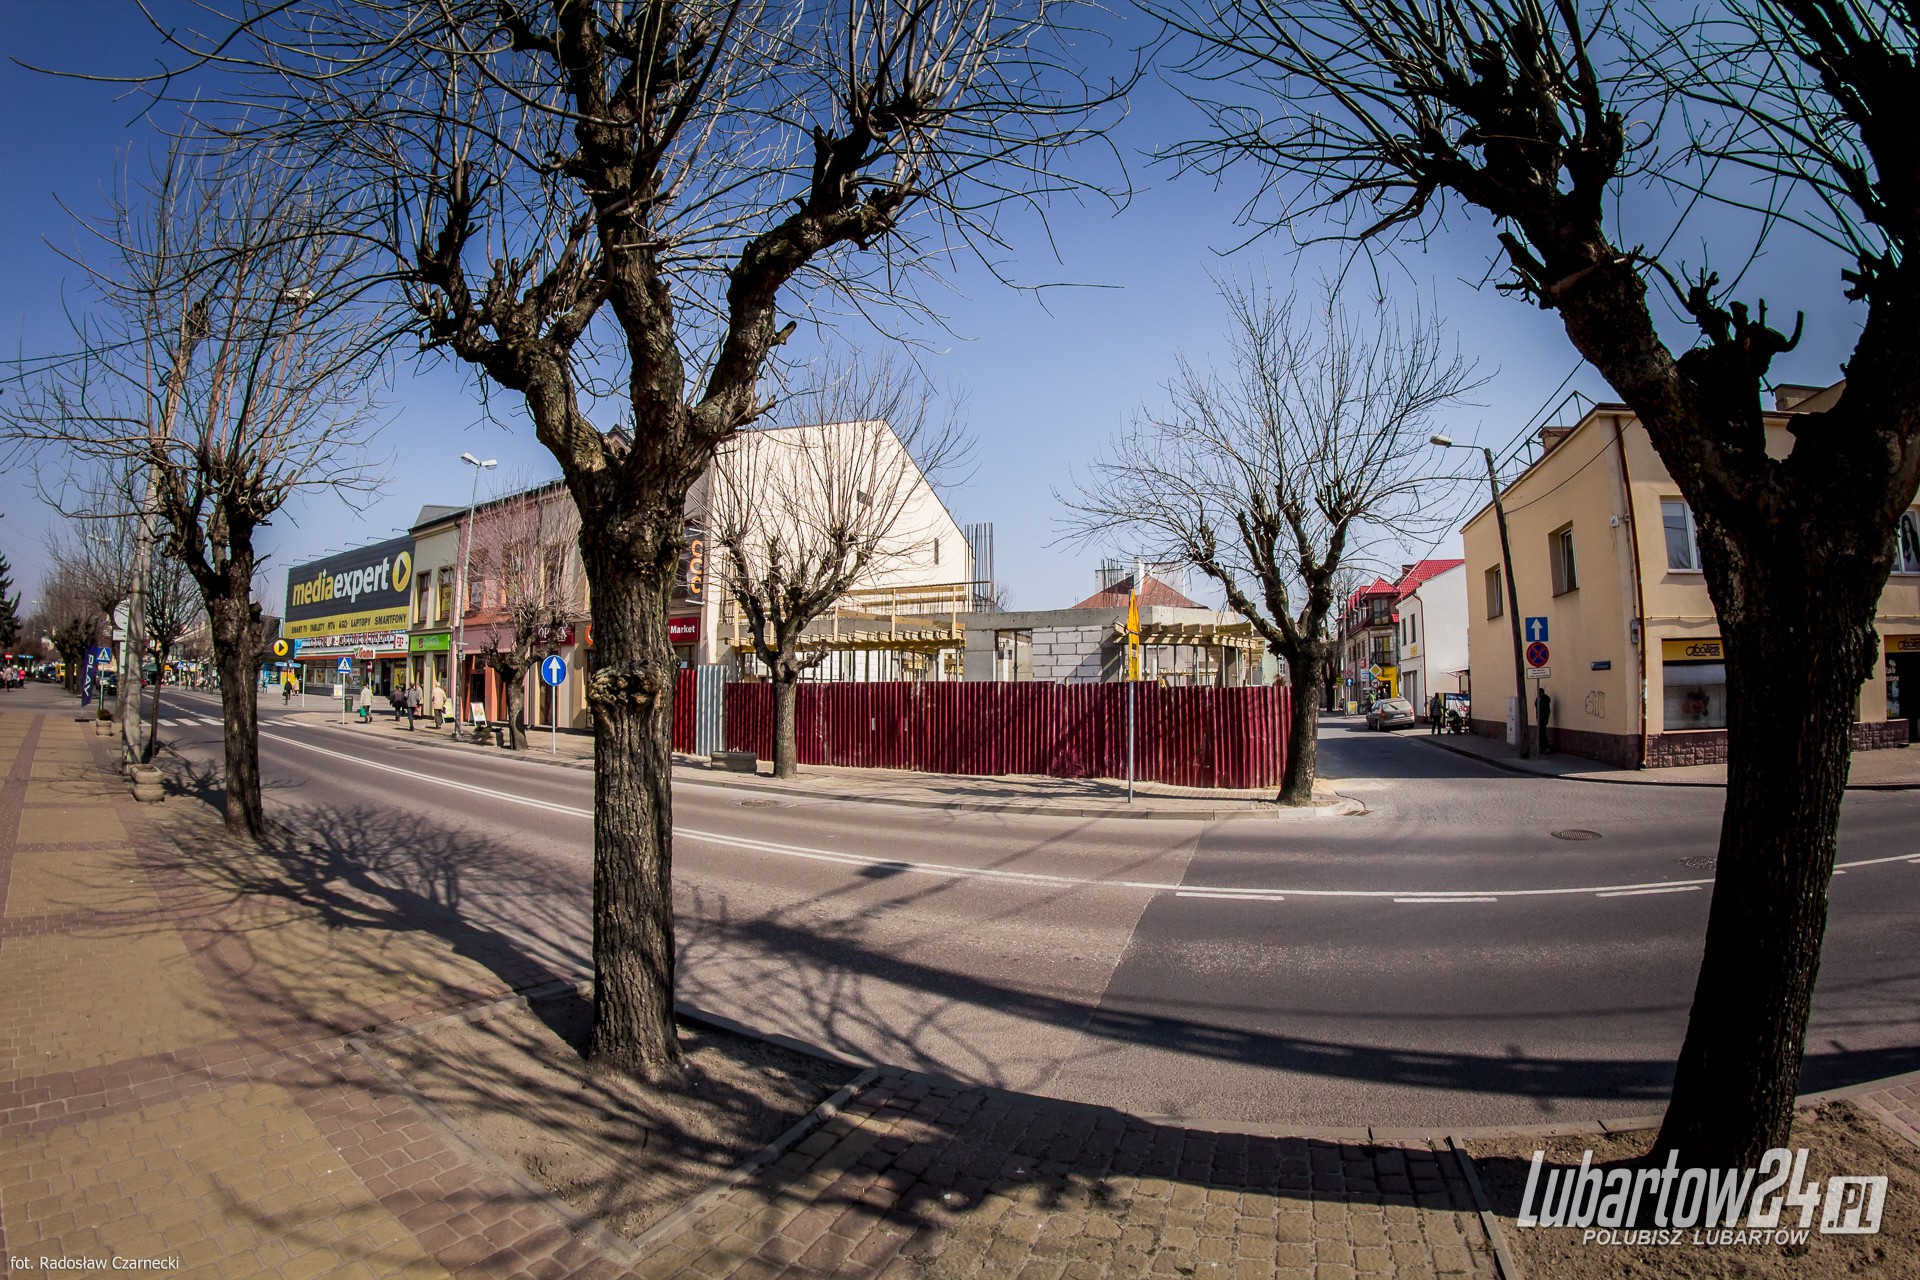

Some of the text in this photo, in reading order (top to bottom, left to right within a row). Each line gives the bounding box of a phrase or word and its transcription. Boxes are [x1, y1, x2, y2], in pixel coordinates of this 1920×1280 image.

[690, 539, 703, 594] CCC
[350, 617, 371, 628] LAPTOPY
[374, 613, 407, 626] SMARTFONY
[670, 625, 695, 634] Market
[84, 654, 95, 697] PLAY
